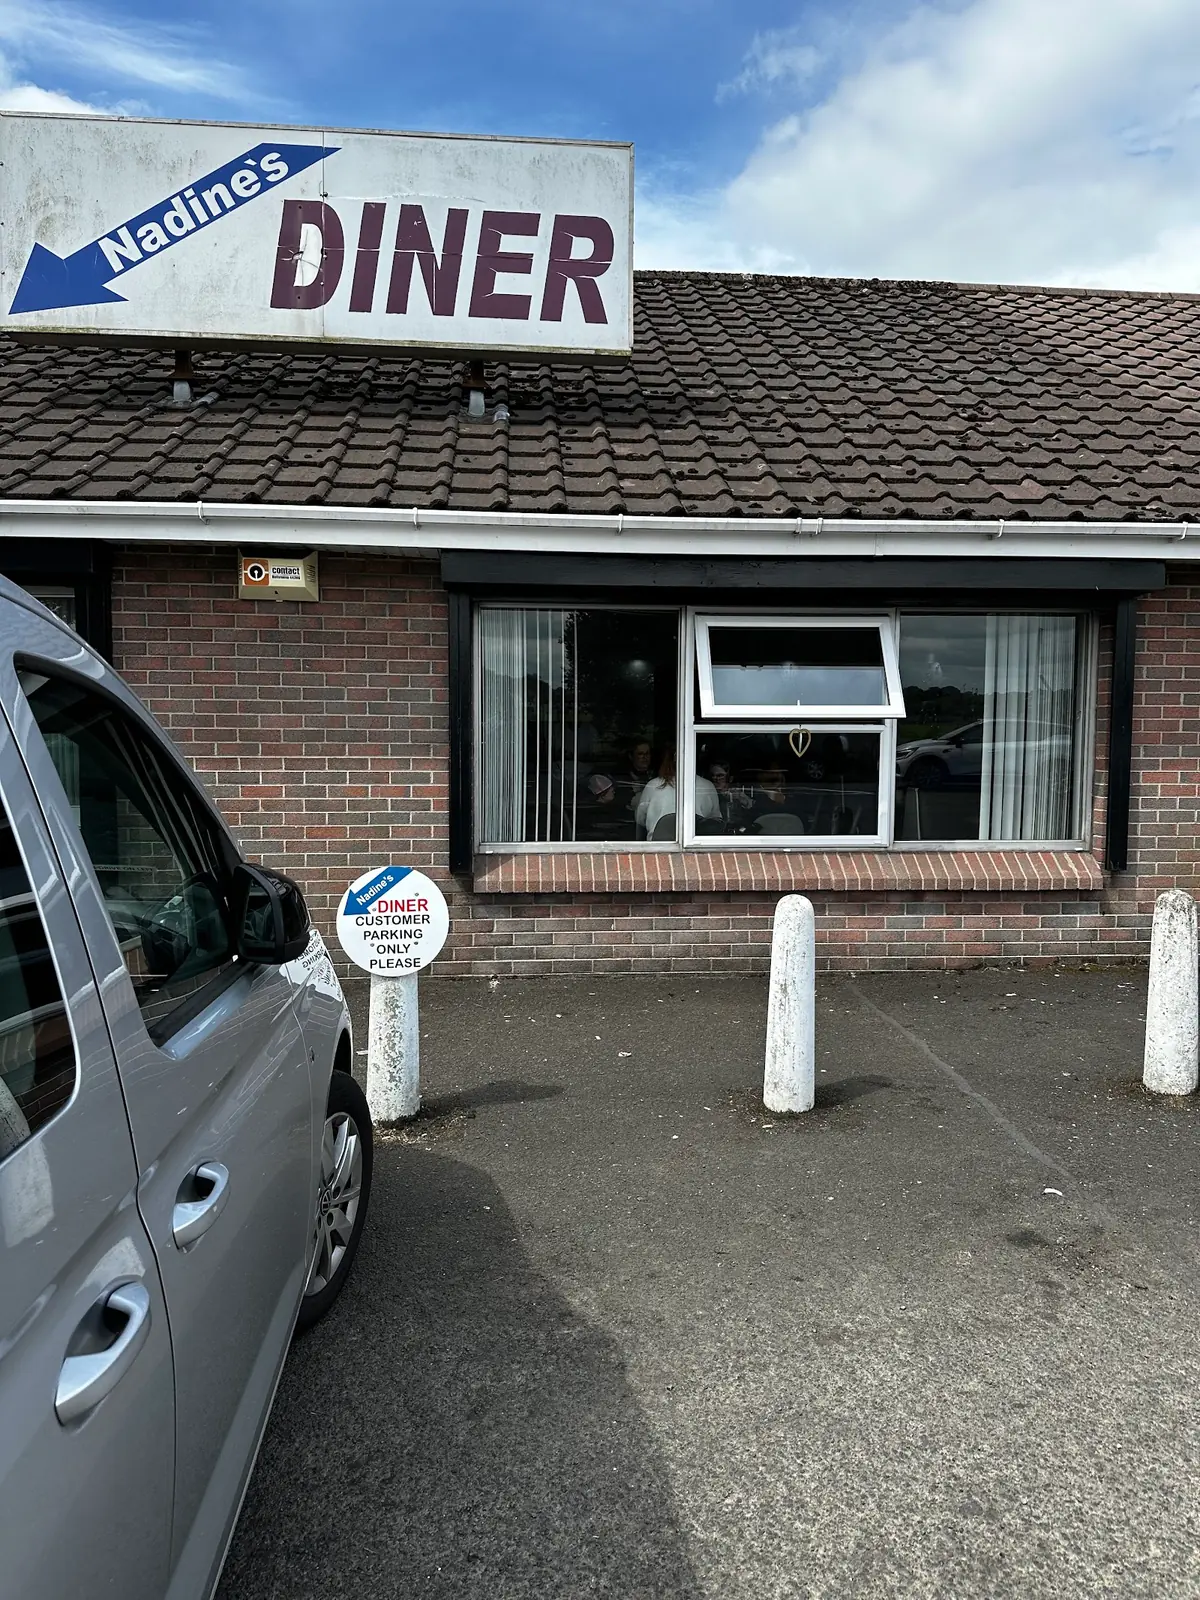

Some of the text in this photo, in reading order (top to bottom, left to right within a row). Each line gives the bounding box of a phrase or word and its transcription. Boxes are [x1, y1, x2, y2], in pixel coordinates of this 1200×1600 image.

[98, 148, 290, 273] Nadine's
[270, 199, 615, 324] DINER
[272, 566, 300, 575] contact
[355, 874, 394, 905] Nadine's
[377, 898, 428, 913] DINER
[355, 914, 431, 926] CUSTOMER
[363, 928, 423, 941] PARKING
[376, 943, 411, 954] ONLY
[369, 957, 421, 969] PLEASE
